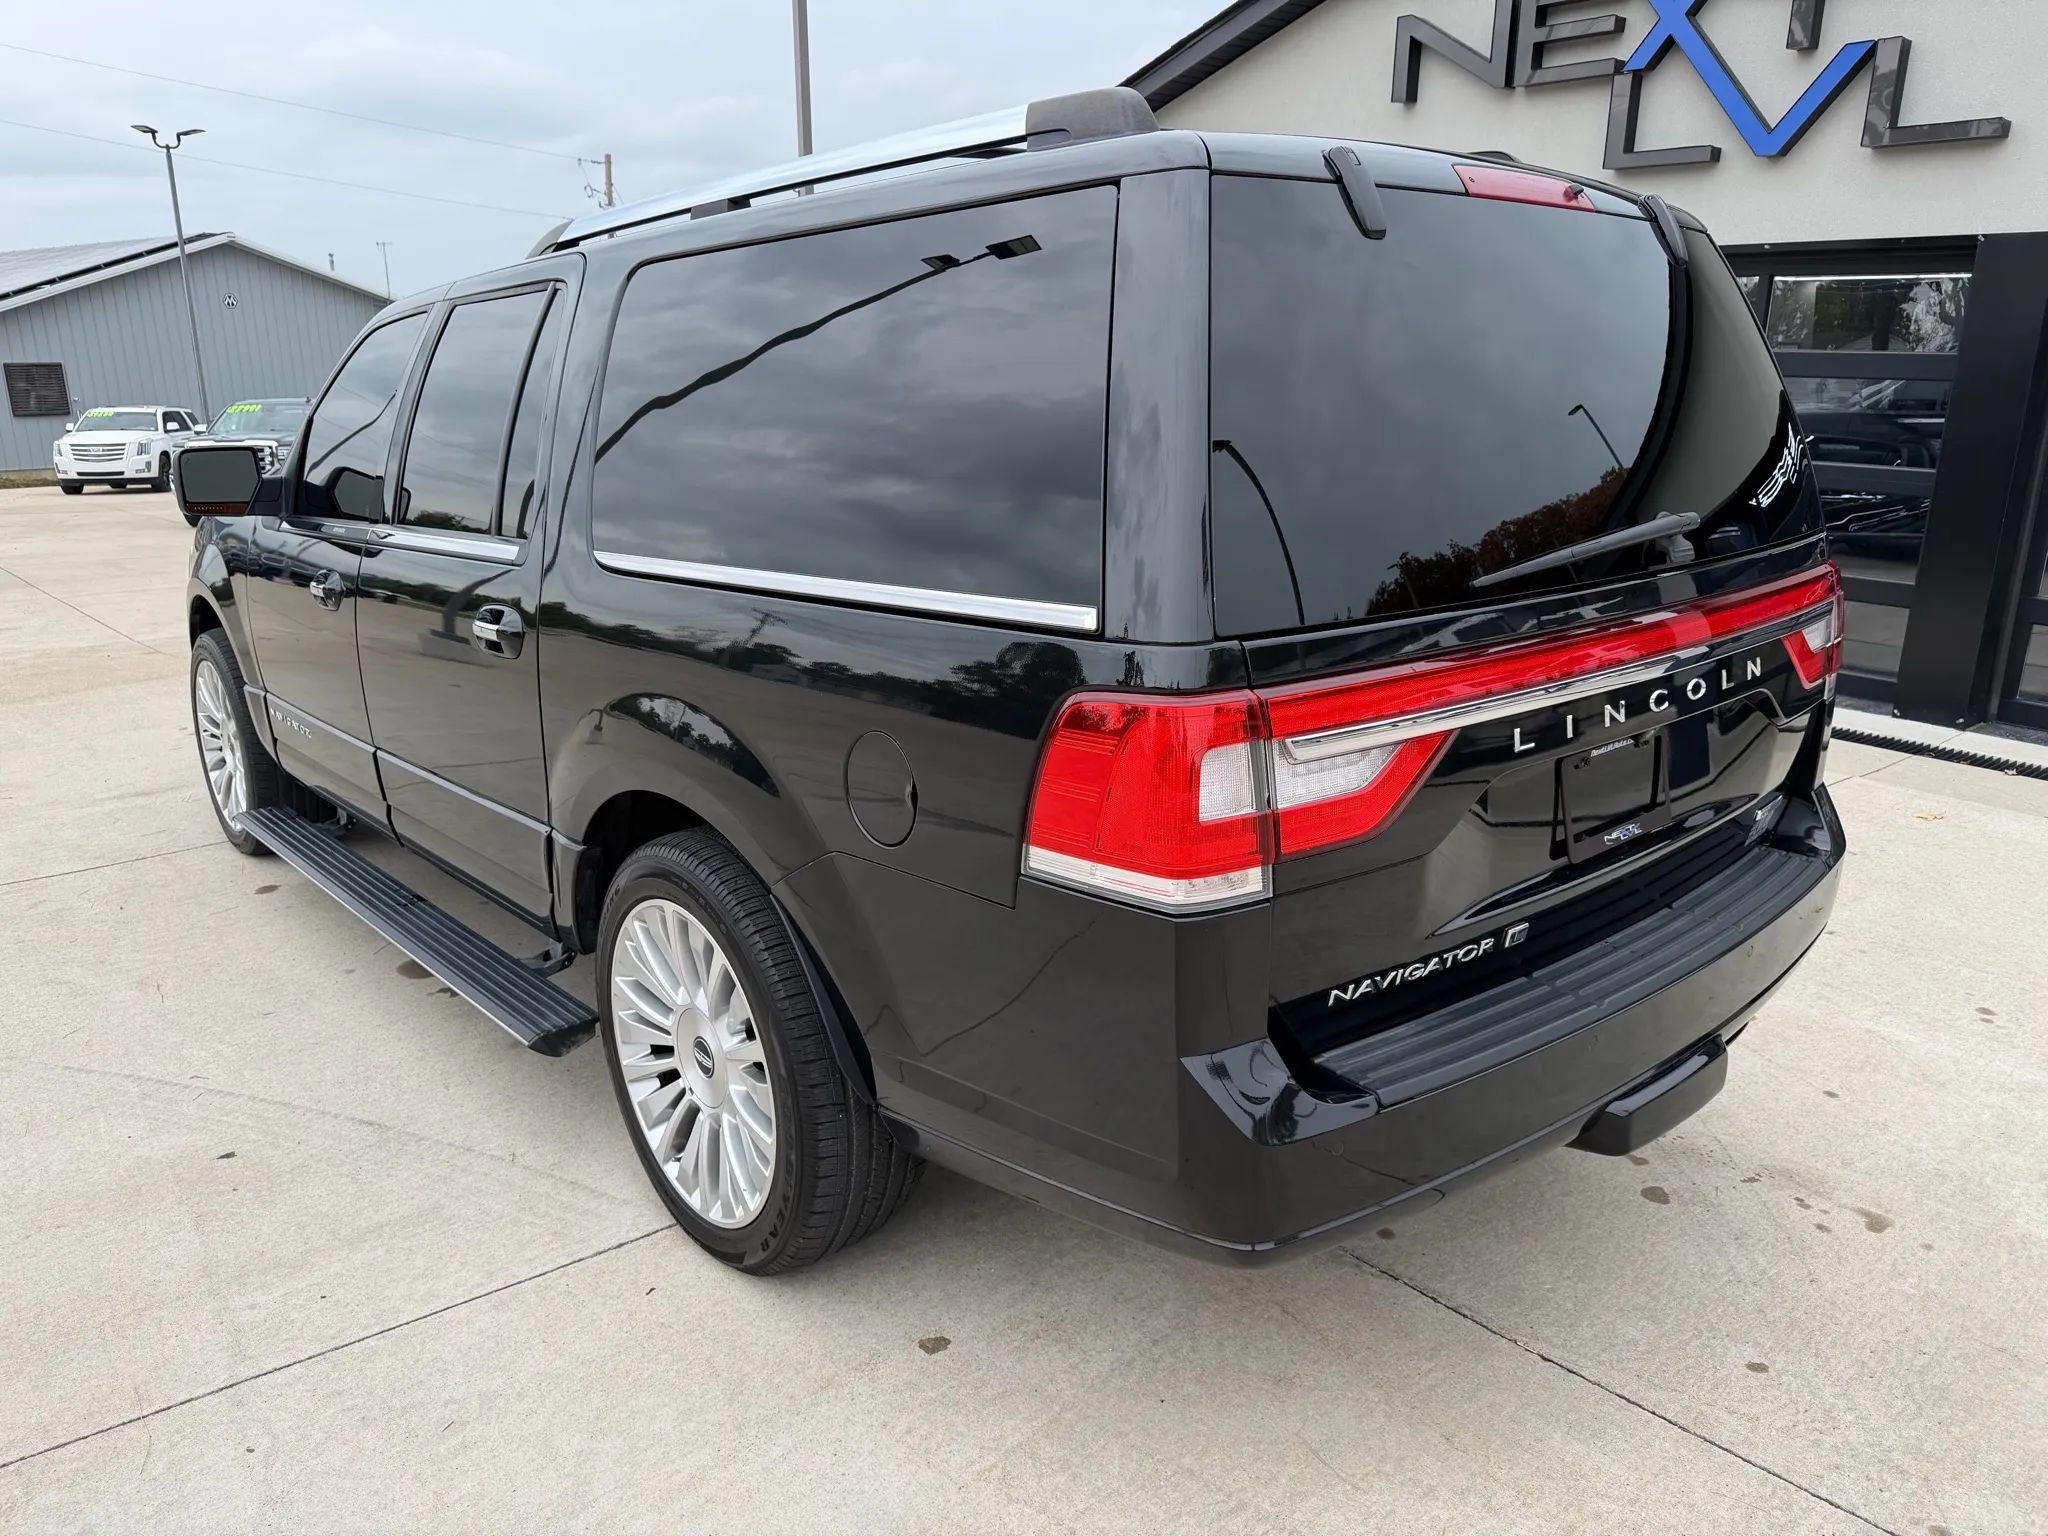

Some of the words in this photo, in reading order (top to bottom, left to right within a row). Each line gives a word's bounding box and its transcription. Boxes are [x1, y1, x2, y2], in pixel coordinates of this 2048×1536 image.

[1602, 36, 2012, 170] LVL
[1513, 656, 1763, 753] LINCOLN
[1327, 937, 1496, 1008] NAVIGATOR
